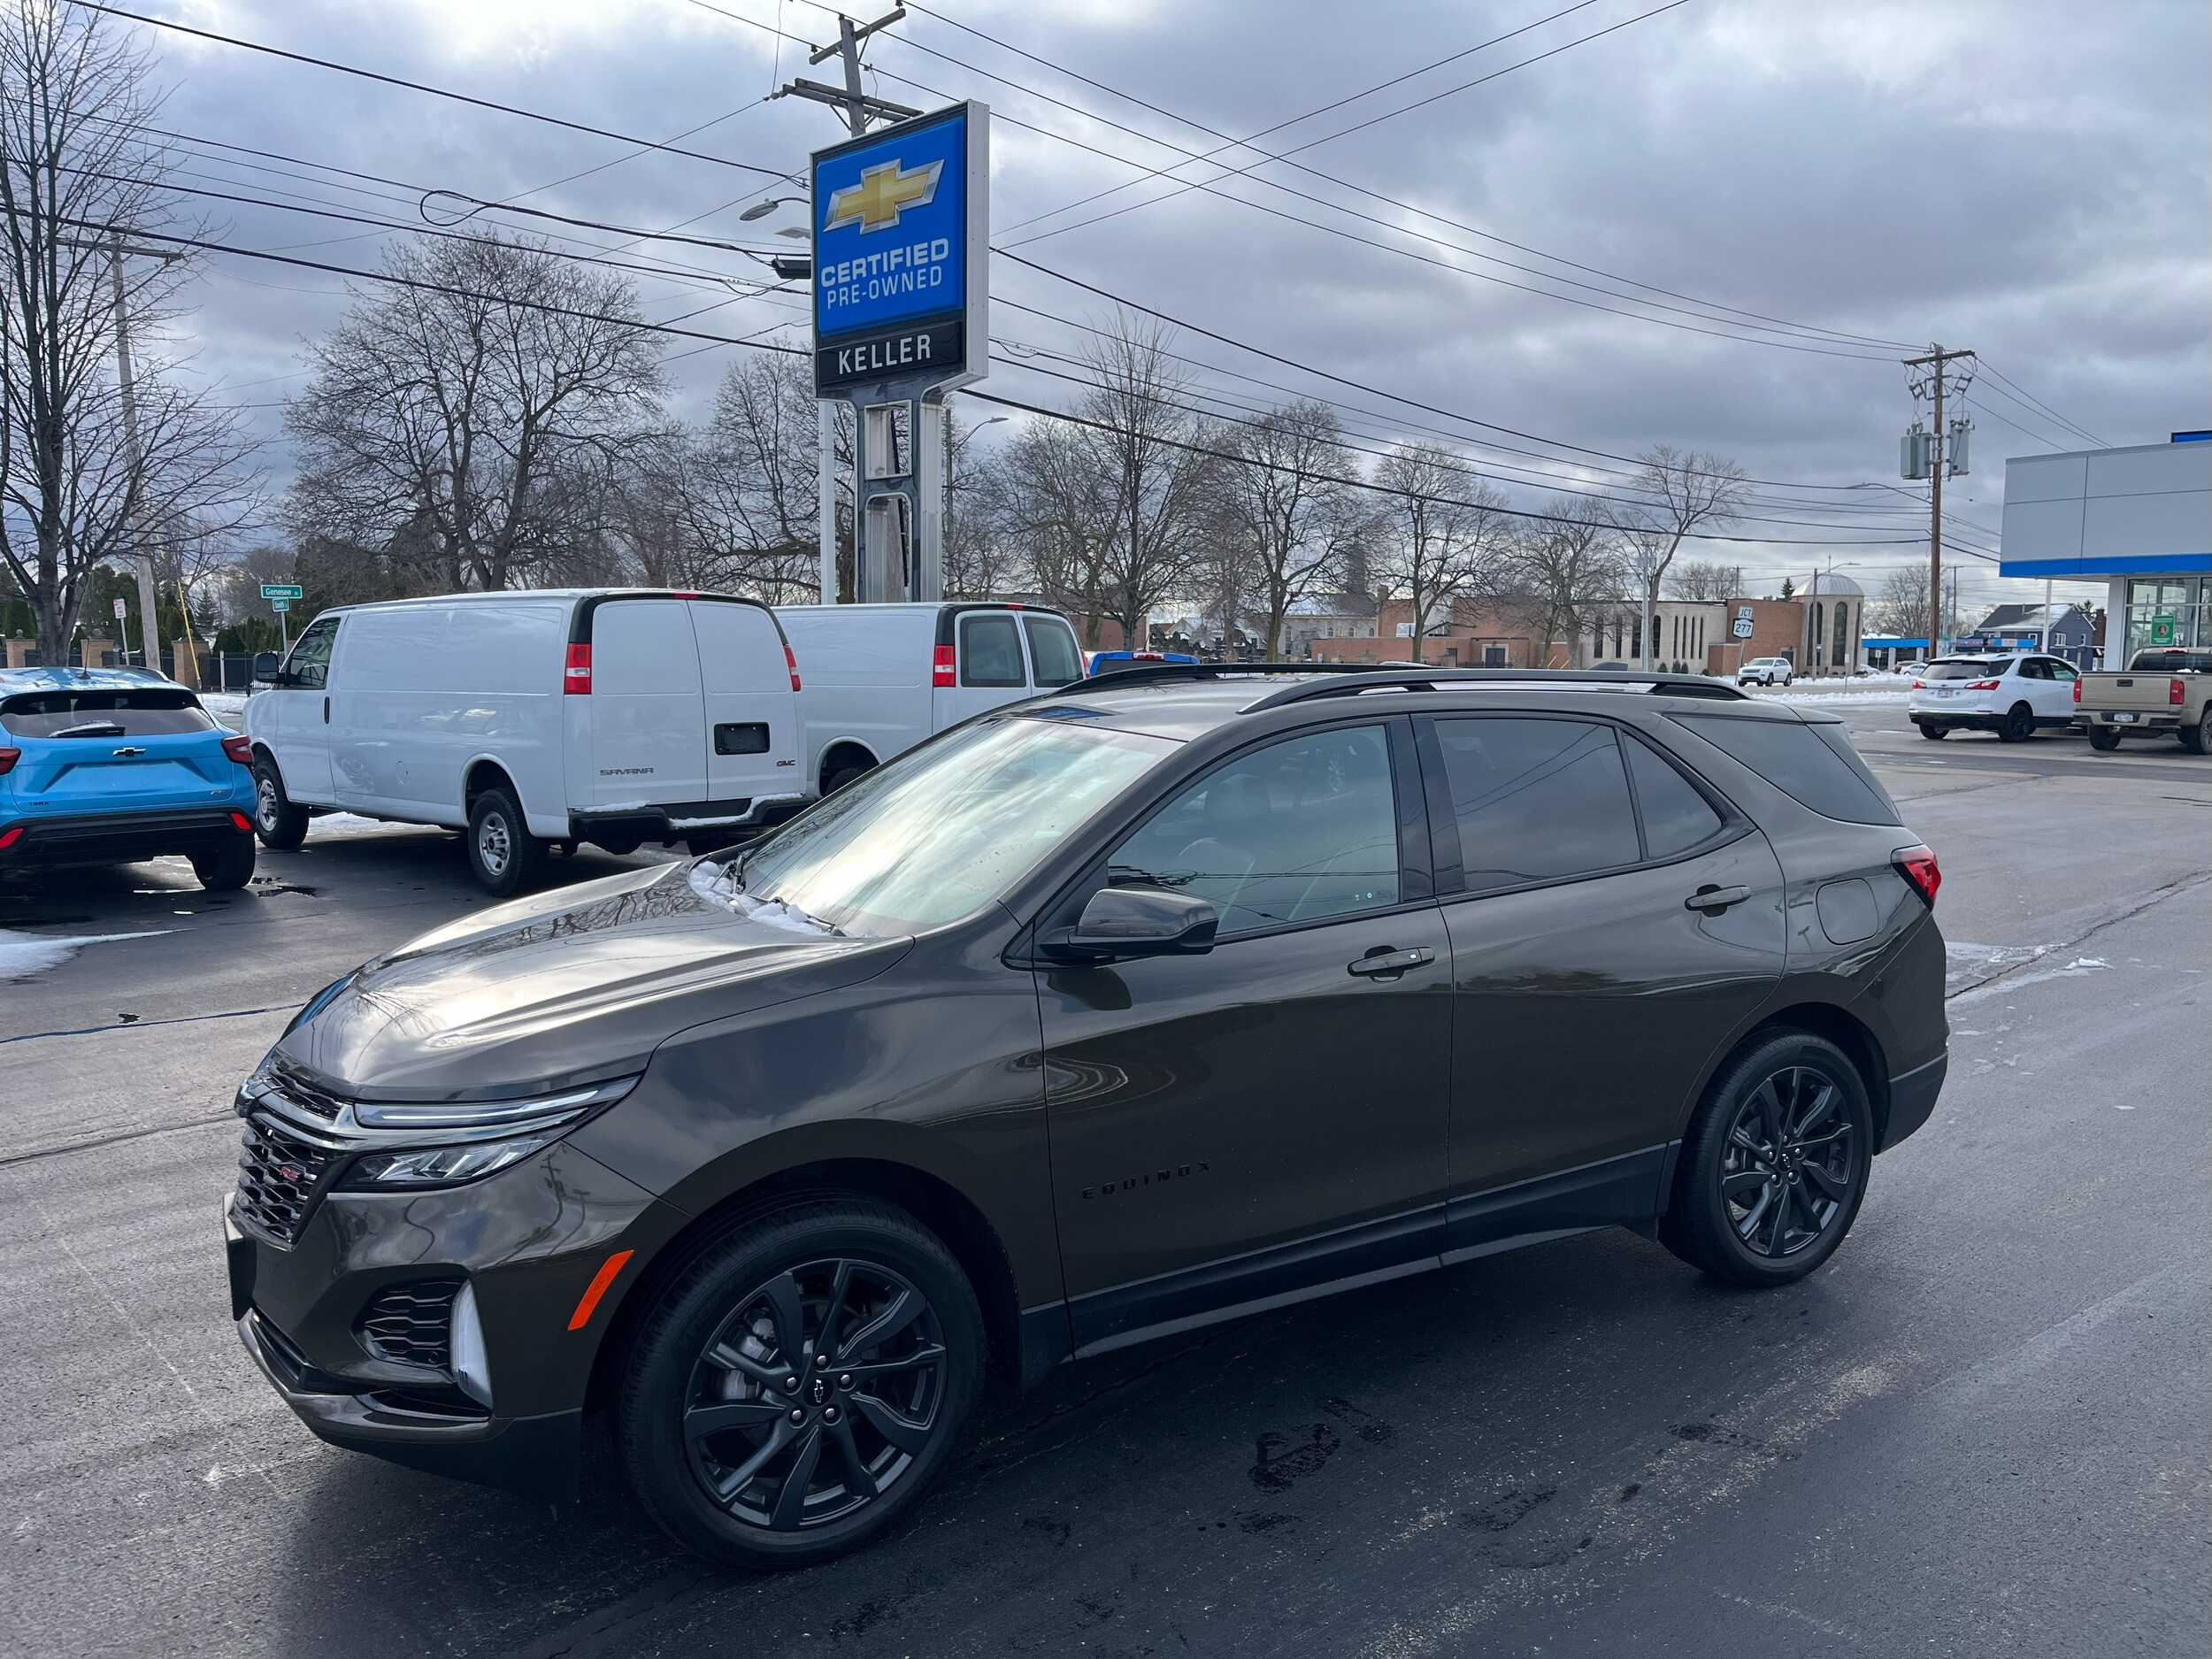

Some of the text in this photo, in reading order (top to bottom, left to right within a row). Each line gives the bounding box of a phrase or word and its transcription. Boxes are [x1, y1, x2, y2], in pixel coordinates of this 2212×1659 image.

[821, 238, 949, 288] CERTIFIED
[827, 265, 941, 310] PRE-OWNED
[839, 334, 931, 374] KELLER
[1740, 608, 1752, 618] JCT
[1735, 623, 1752, 634] 277
[600, 767, 654, 776] SAVANA
[280, 1166, 300, 1182] RS
[1081, 1159, 1210, 1200] EQUINOX
